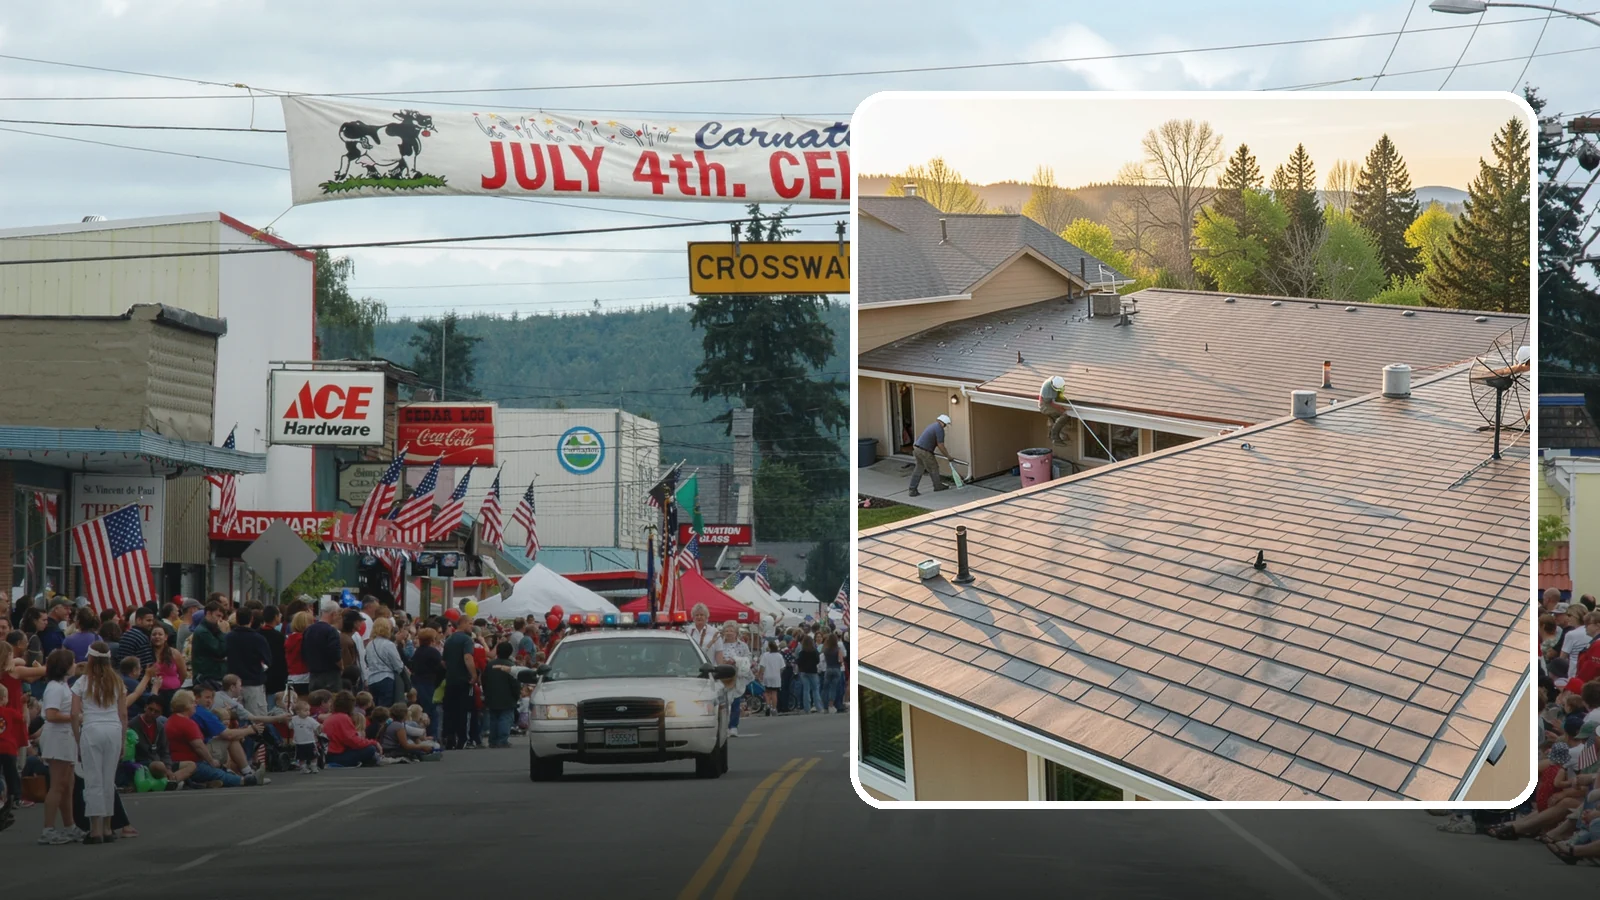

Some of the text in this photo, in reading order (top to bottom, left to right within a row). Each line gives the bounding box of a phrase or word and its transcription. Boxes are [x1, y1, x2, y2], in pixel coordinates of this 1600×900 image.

[481, 141, 604, 192] JULY
[632, 149, 746, 197] 4th.
[697, 254, 850, 280] CROSSWA
[282, 380, 373, 420] ACE
[405, 409, 485, 422] CEDAR LOG
[283, 421, 371, 437] Hardware
[416, 428, 477, 447] Coca-Cola
[96, 485, 124, 495] Vincent
[126, 485, 136, 495] de
[138, 486, 155, 496] Paul
[688, 526, 741, 535] CRNATION
